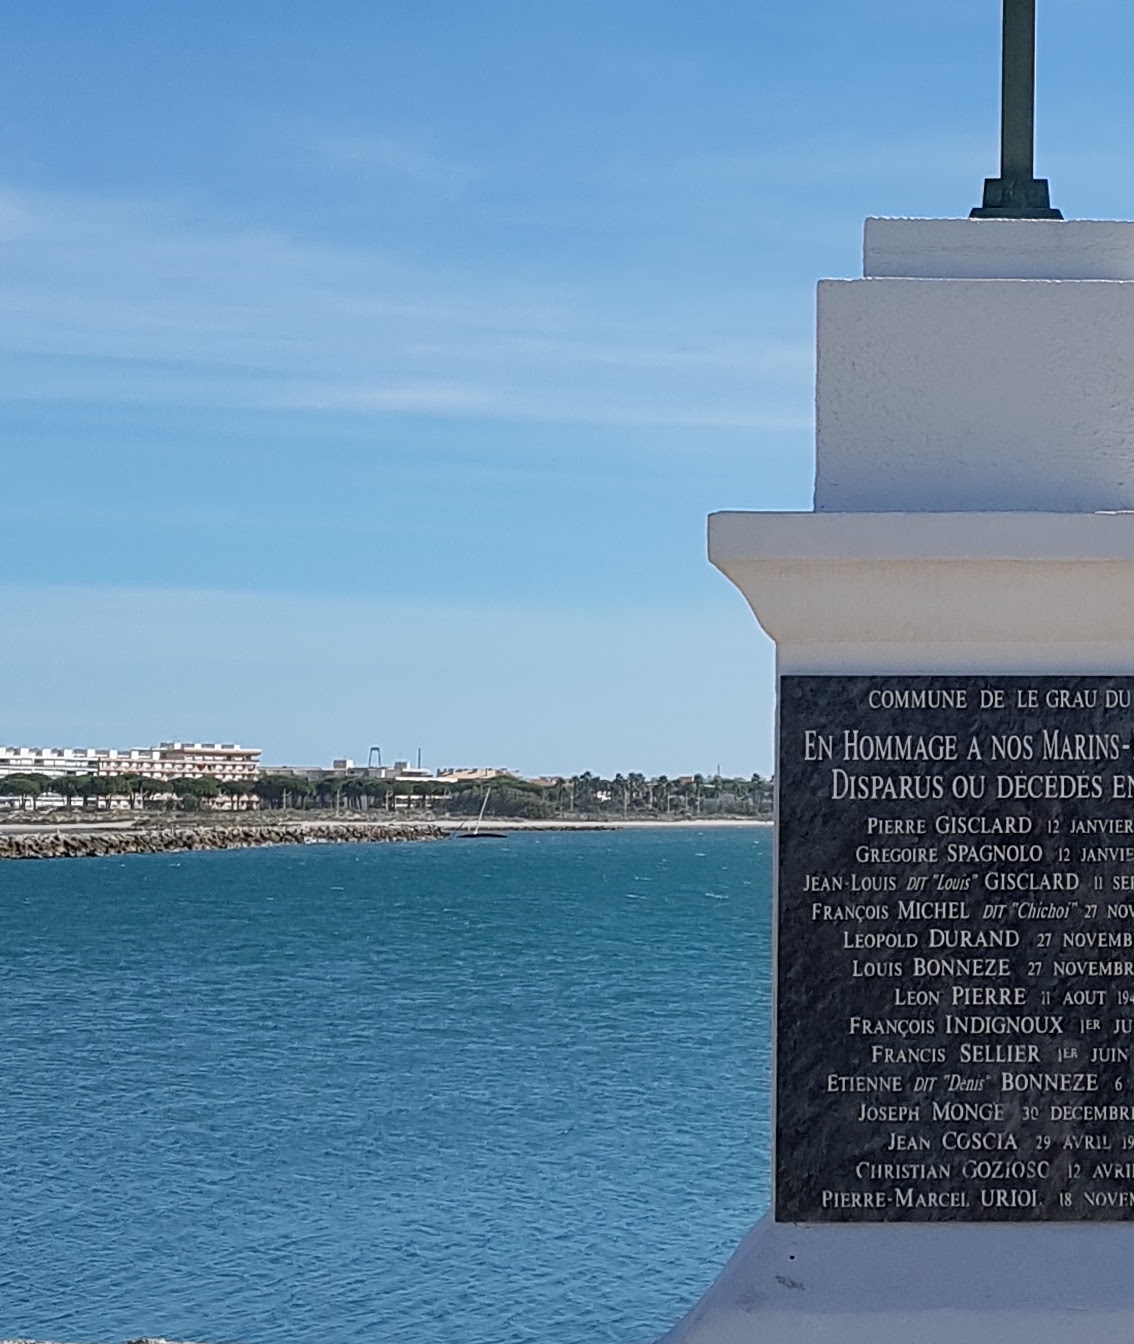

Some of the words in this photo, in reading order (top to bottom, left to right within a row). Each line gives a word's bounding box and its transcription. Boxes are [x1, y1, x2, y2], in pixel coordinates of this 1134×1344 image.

[868, 689, 968, 709] COMMUNE
[980, 689, 1005, 709] DE
[1016, 689, 1039, 709] LE
[1046, 689, 1098, 709] GRAU
[1104, 689, 1132, 709] DU
[804, 730, 834, 761] EN
[843, 729, 958, 761] HOMMAGE
[967, 735, 982, 761] A
[991, 734, 1034, 761] NOS
[831, 768, 944, 800] DISPARUS
[952, 775, 985, 799] OU
[867, 817, 927, 834] PIERRE
[935, 815, 1033, 834] GISCLARD
[1047, 819, 1060, 834] 12
[1069, 819, 1134, 834] JANVIER
[855, 845, 938, 863] GREGOIRE
[947, 844, 1043, 863] SPAGNOLO
[1058, 848, 1071, 862] 12
[803, 874, 897, 892] JEAN-LOUIS
[906, 876, 929, 891] DIT
[932, 873, 979, 891] "Louis"
[985, 872, 1080, 891] GISCLARD
[1094, 876, 1103, 890] 11
[812, 902, 889, 924] FRANÇOIS
[897, 901, 970, 920] MICHEL
[982, 904, 1007, 919] DIT
[1084, 904, 1098, 919] 27
[843, 931, 919, 949] LEOPOLD
[928, 929, 1020, 948] DURAND
[1036, 932, 1052, 948] 27
[852, 960, 903, 977] LOUIS
[913, 958, 1011, 977] BONNEZE
[1027, 961, 1042, 976] 27
[895, 988, 941, 1006] LEON
[952, 986, 1026, 1006] PIERRE
[1062, 991, 1107, 1006] AOUT
[849, 1017, 935, 1037] FRANÇOIS
[945, 1015, 1064, 1034] INDIGNOUX
[1080, 1019, 1101, 1034] 1ER
[871, 1045, 946, 1063] FRANCIS
[960, 1043, 1041, 1063] SELLIER
[1090, 1048, 1129, 1063] JUIN
[827, 1074, 903, 1092] ETIENNE
[913, 1076, 938, 1092] DIT
[1001, 1072, 1099, 1092] BONNEZE
[1114, 1077, 1123, 1092] 6
[858, 1103, 920, 1122] JOSEPH
[932, 1102, 1005, 1121] MONGE
[1022, 1107, 1039, 1121] 30
[888, 1133, 931, 1151] JEAN
[942, 1131, 1018, 1150] COSCIA
[1035, 1135, 1051, 1150] 29
[1062, 1135, 1112, 1150] AVRIL
[855, 1161, 951, 1179] CHRISTIAN
[962, 1160, 1050, 1179] GOZIOSO
[1068, 1164, 1081, 1179] 12
[821, 1188, 970, 1208] PIERRE-MARCEL
[1059, 1192, 1072, 1207] 18
